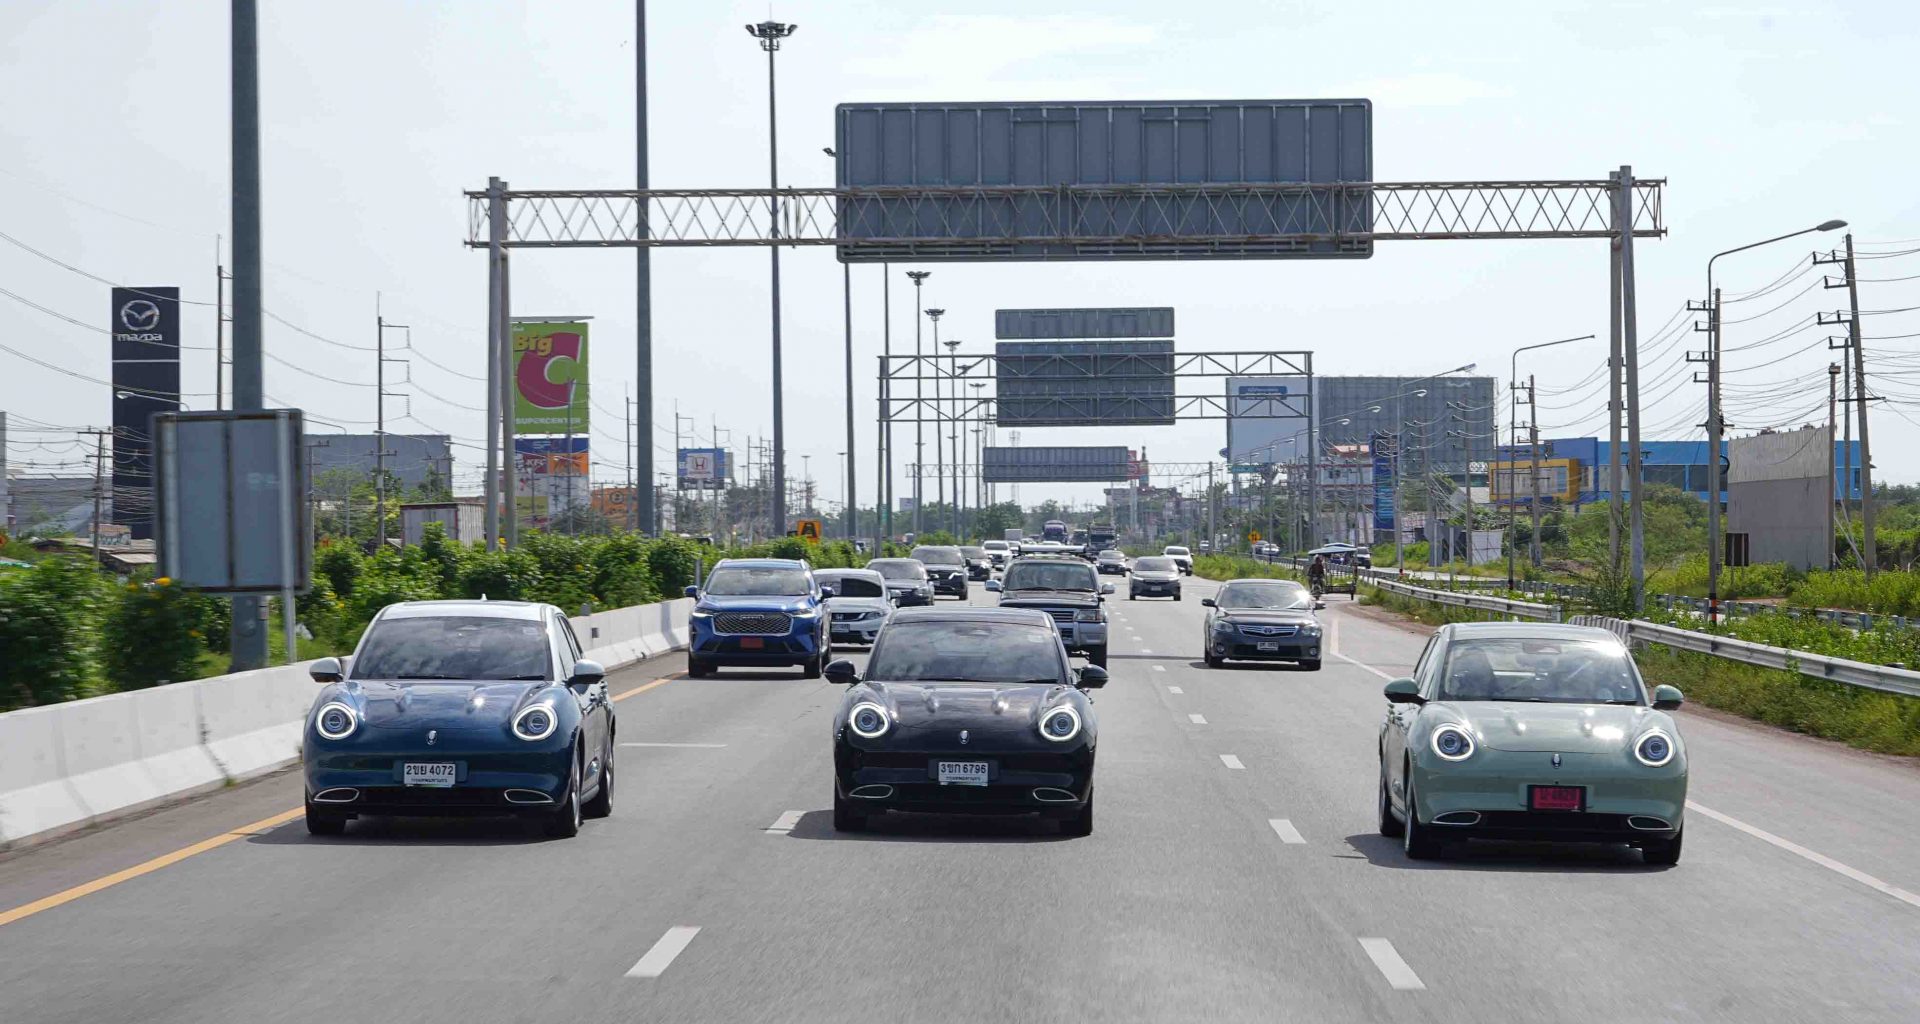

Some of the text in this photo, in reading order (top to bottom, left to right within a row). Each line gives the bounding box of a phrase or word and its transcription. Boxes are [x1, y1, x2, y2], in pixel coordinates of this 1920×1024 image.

[513, 332, 553, 357] Big
[517, 331, 583, 409] C
[429, 765, 453, 775] 4072
[962, 764, 986, 774] 6796
